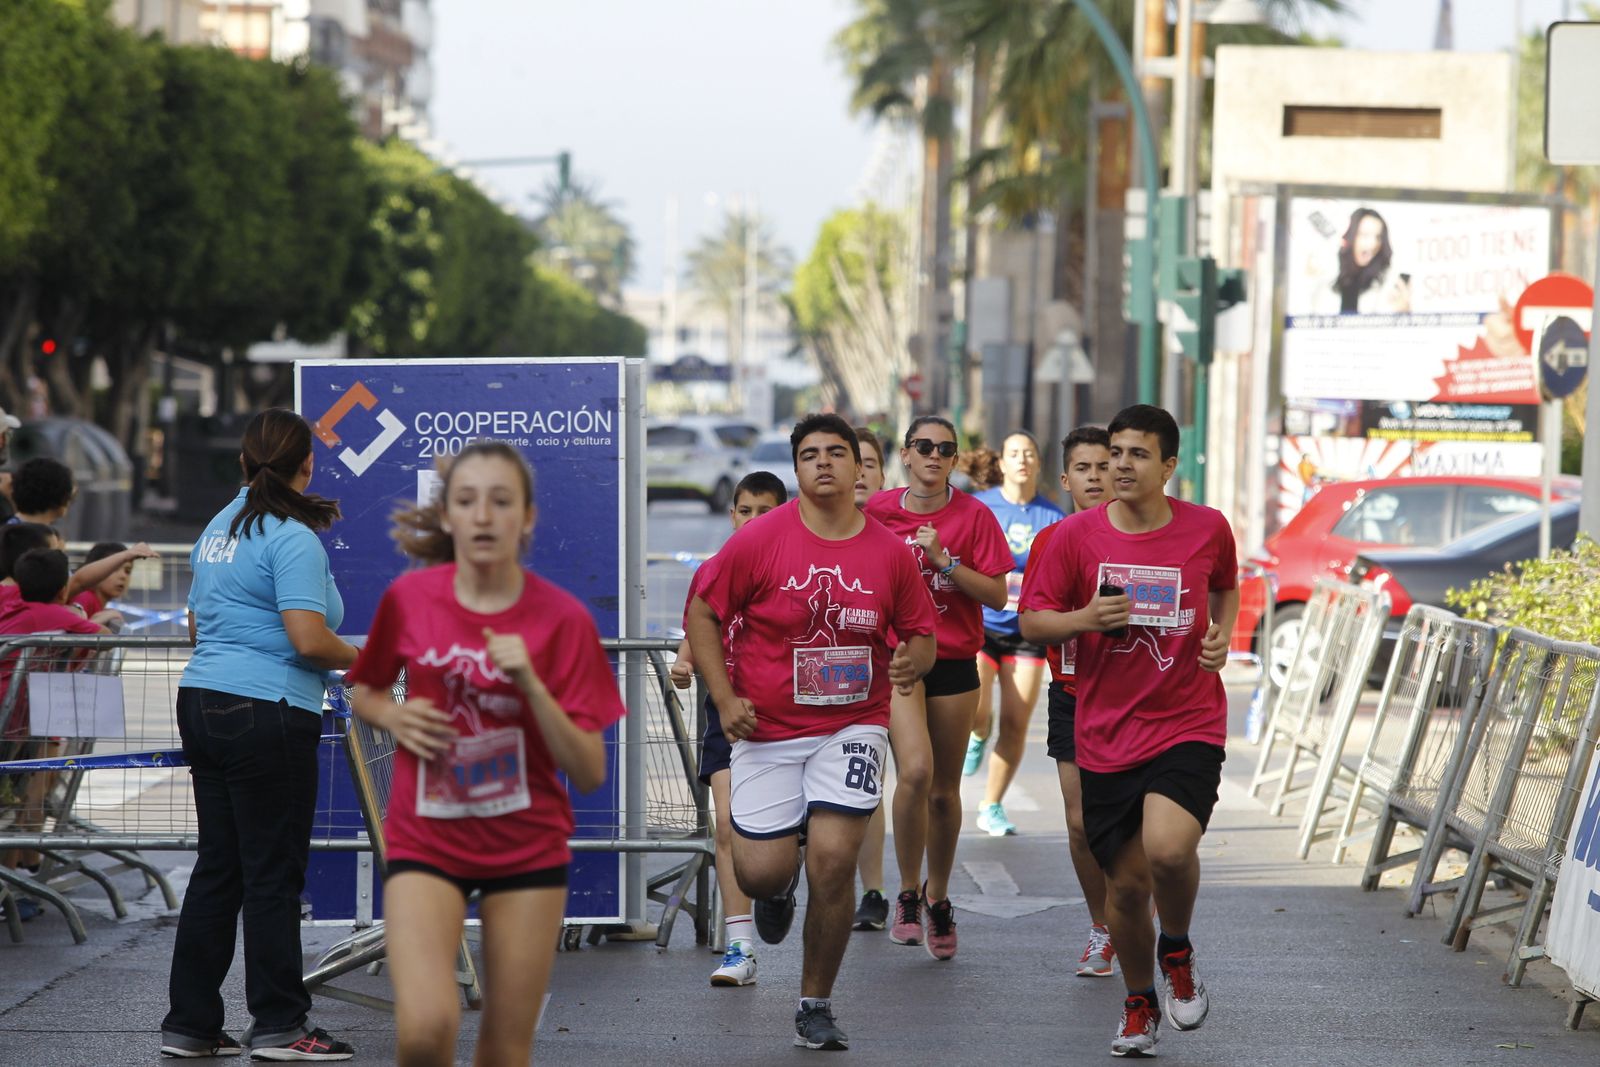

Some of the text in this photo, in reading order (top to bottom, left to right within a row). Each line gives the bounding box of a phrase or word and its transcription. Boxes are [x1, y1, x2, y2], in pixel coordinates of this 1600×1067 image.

[1416, 226, 1538, 263] TODO TIENE
[414, 405, 612, 435] COOPERACIÓN
[536, 436, 560, 447] ocio
[562, 438, 569, 448] y
[573, 436, 612, 446] cultura
[1123, 584, 1175, 604] 1652
[836, 607, 847, 630] 4
[820, 664, 868, 683] 1792
[842, 742, 868, 755] NEW
[845, 756, 878, 796] 86
